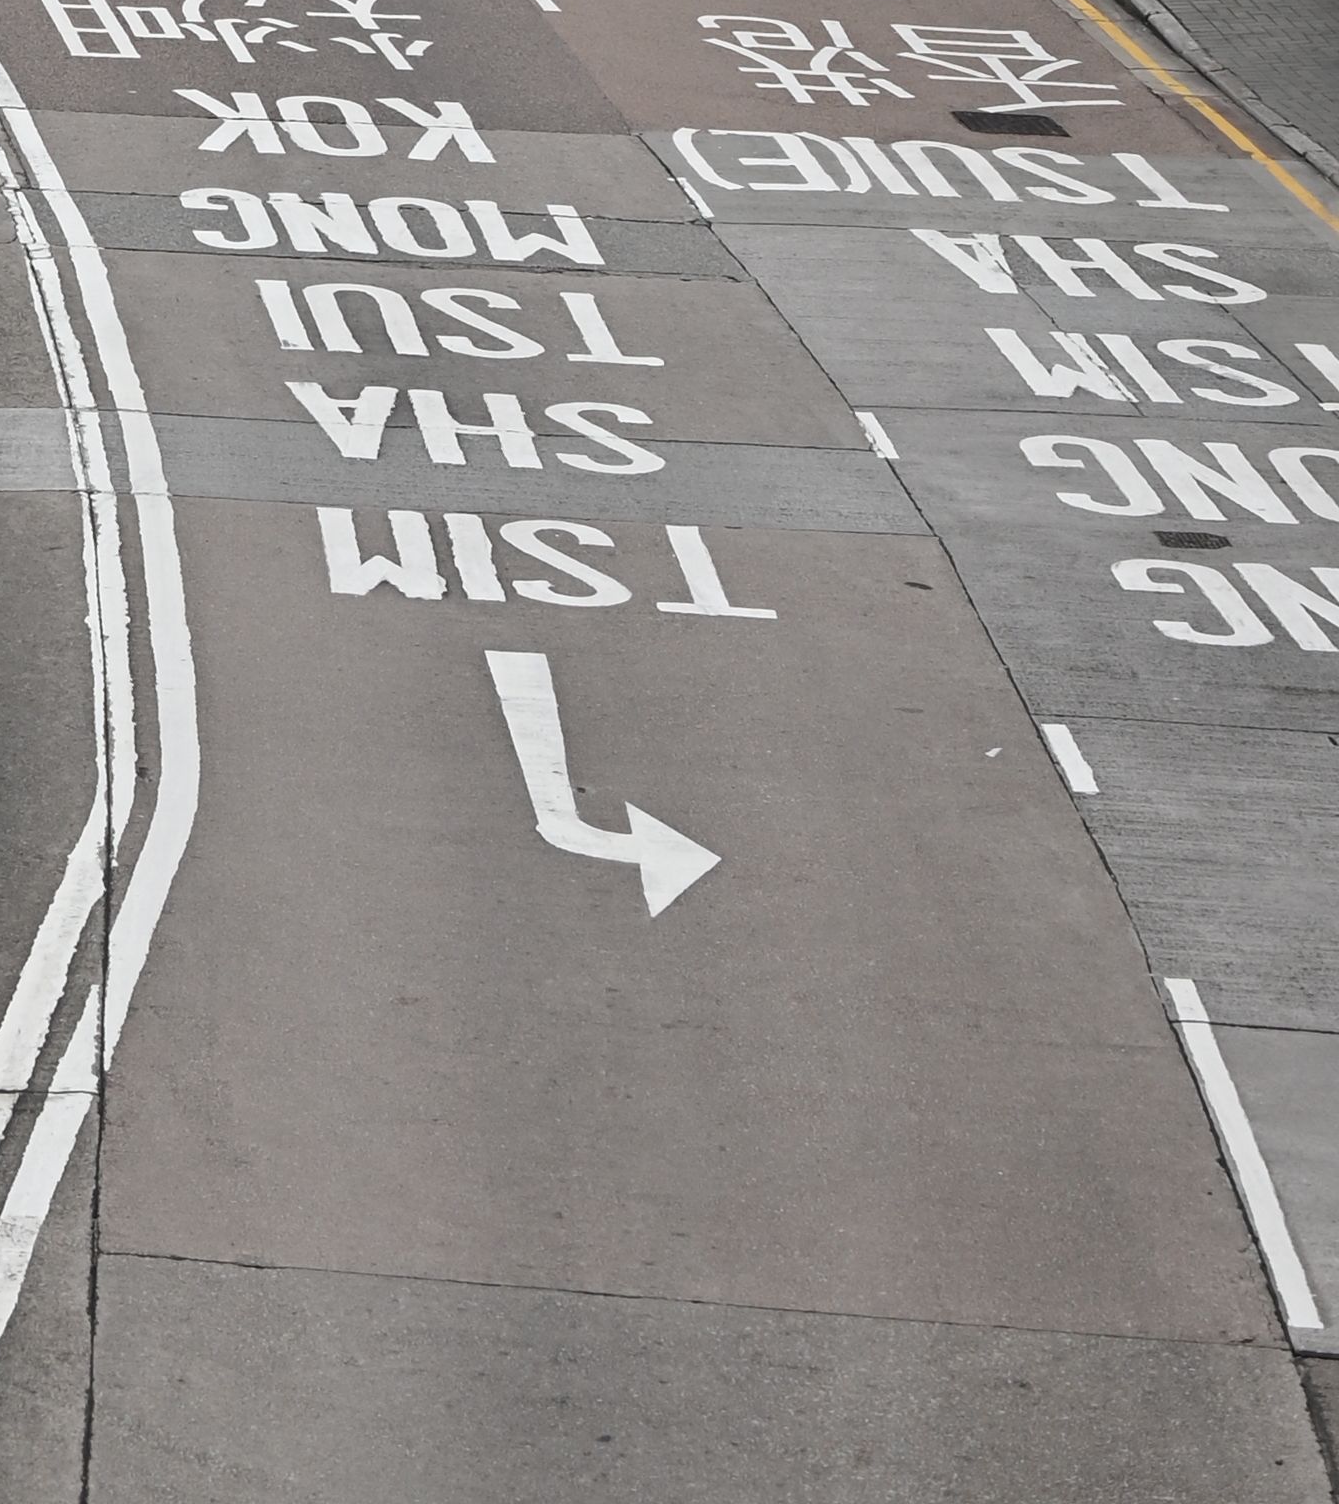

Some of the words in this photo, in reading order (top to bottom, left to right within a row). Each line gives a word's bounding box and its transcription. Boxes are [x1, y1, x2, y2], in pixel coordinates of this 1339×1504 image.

[697, 14, 1123, 114] 香港
[173, 89, 497, 164] KOK
[178, 187, 606, 266] MONG
[908, 228, 1269, 306] SHA
[254, 279, 665, 367] TSUI
[284, 381, 666, 475] SHA
[316, 507, 778, 620] TSIM
